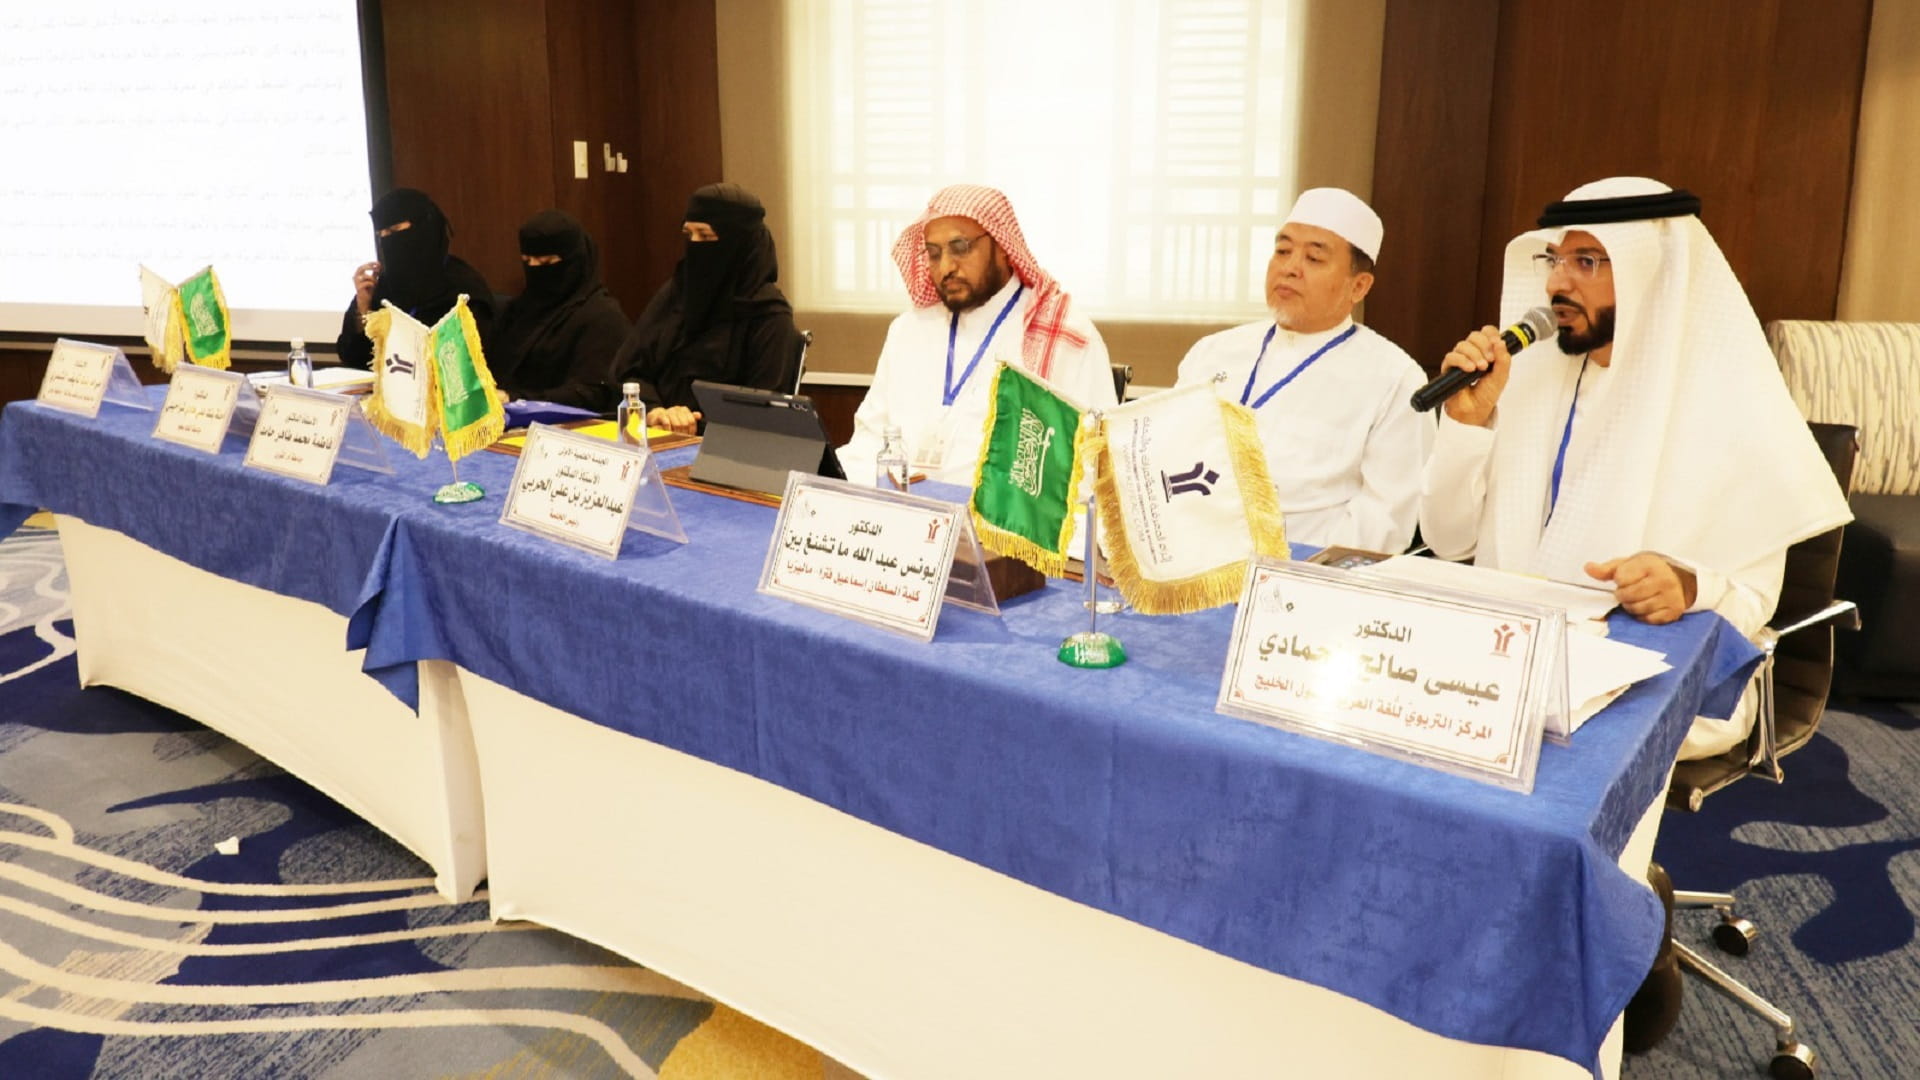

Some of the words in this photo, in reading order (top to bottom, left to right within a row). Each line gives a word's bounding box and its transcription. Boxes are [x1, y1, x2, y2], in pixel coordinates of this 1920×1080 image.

[550, 484, 568, 502] علي
[568, 487, 580, 506] بن
[848, 519, 882, 536] الدكتور
[784, 530, 803, 552] بين
[852, 546, 874, 562] الله
[876, 553, 898, 572] عبد
[900, 557, 936, 584] يونس
[833, 572, 868, 592] إسماعيل
[867, 580, 901, 598] السلطان
[902, 586, 920, 603] كلية
[1354, 620, 1412, 643] الدكتور
[1258, 632, 1339, 662] حمادي
[1359, 652, 1418, 683] صالح
[1254, 673, 1294, 692] الخليج
[1423, 678, 1500, 706] عيسى
[1456, 720, 1492, 740] المركز
